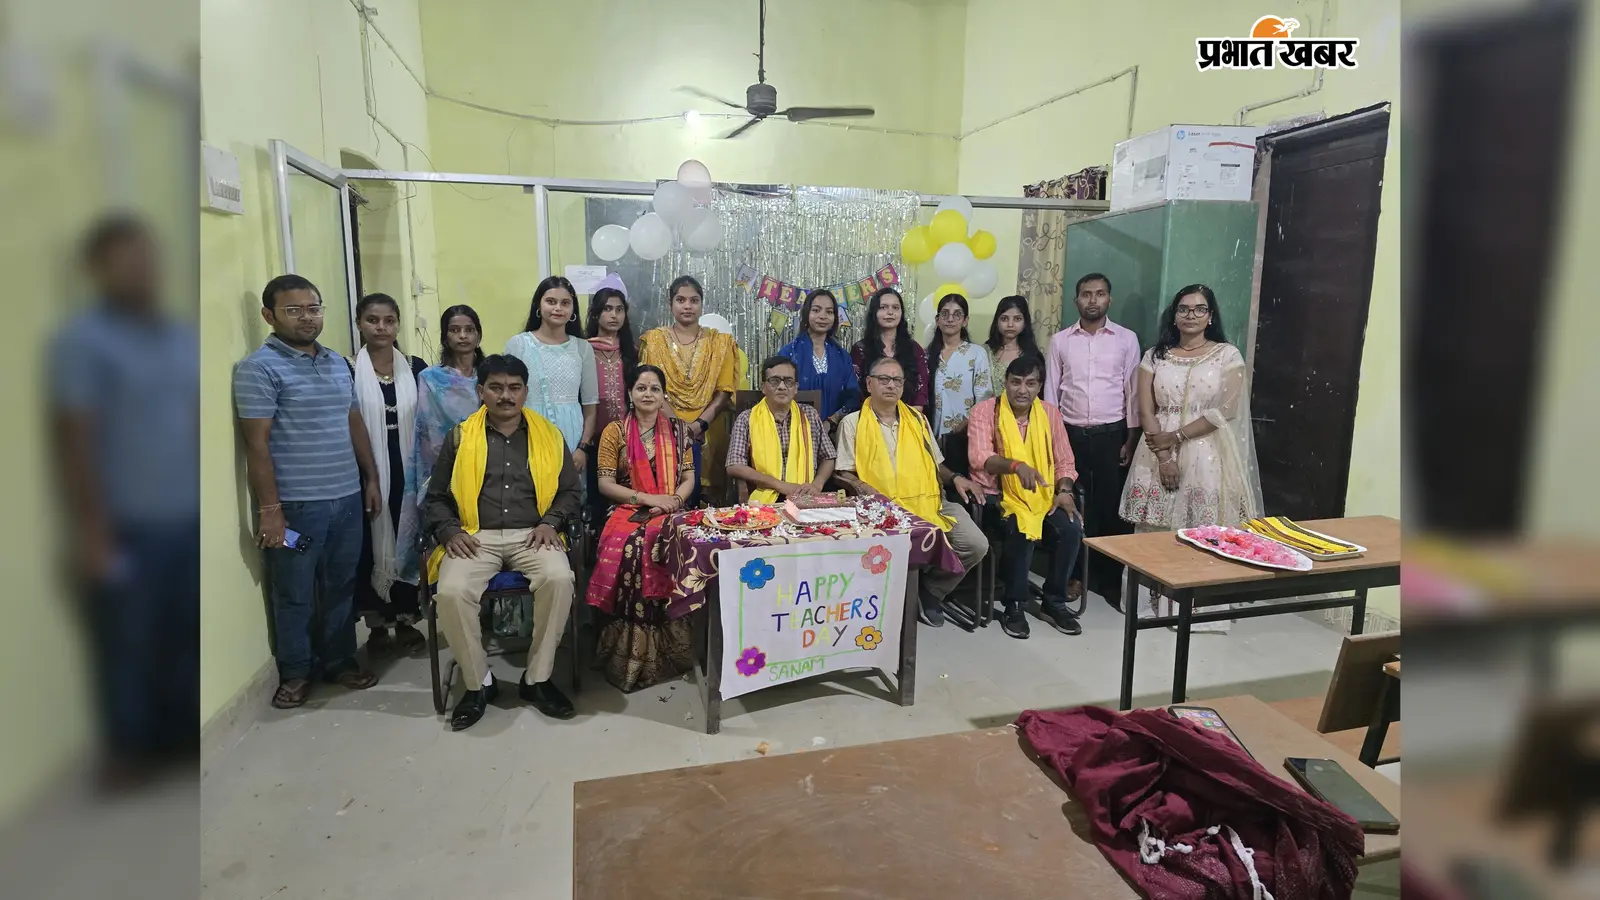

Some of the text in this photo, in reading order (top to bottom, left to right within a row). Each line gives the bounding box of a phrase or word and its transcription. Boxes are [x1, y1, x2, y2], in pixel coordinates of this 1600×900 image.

[763, 268, 894, 305] TEAHERS
[776, 572, 855, 606] HAPPY
[802, 624, 848, 649] DAY
[768, 656, 825, 682] SANAM
